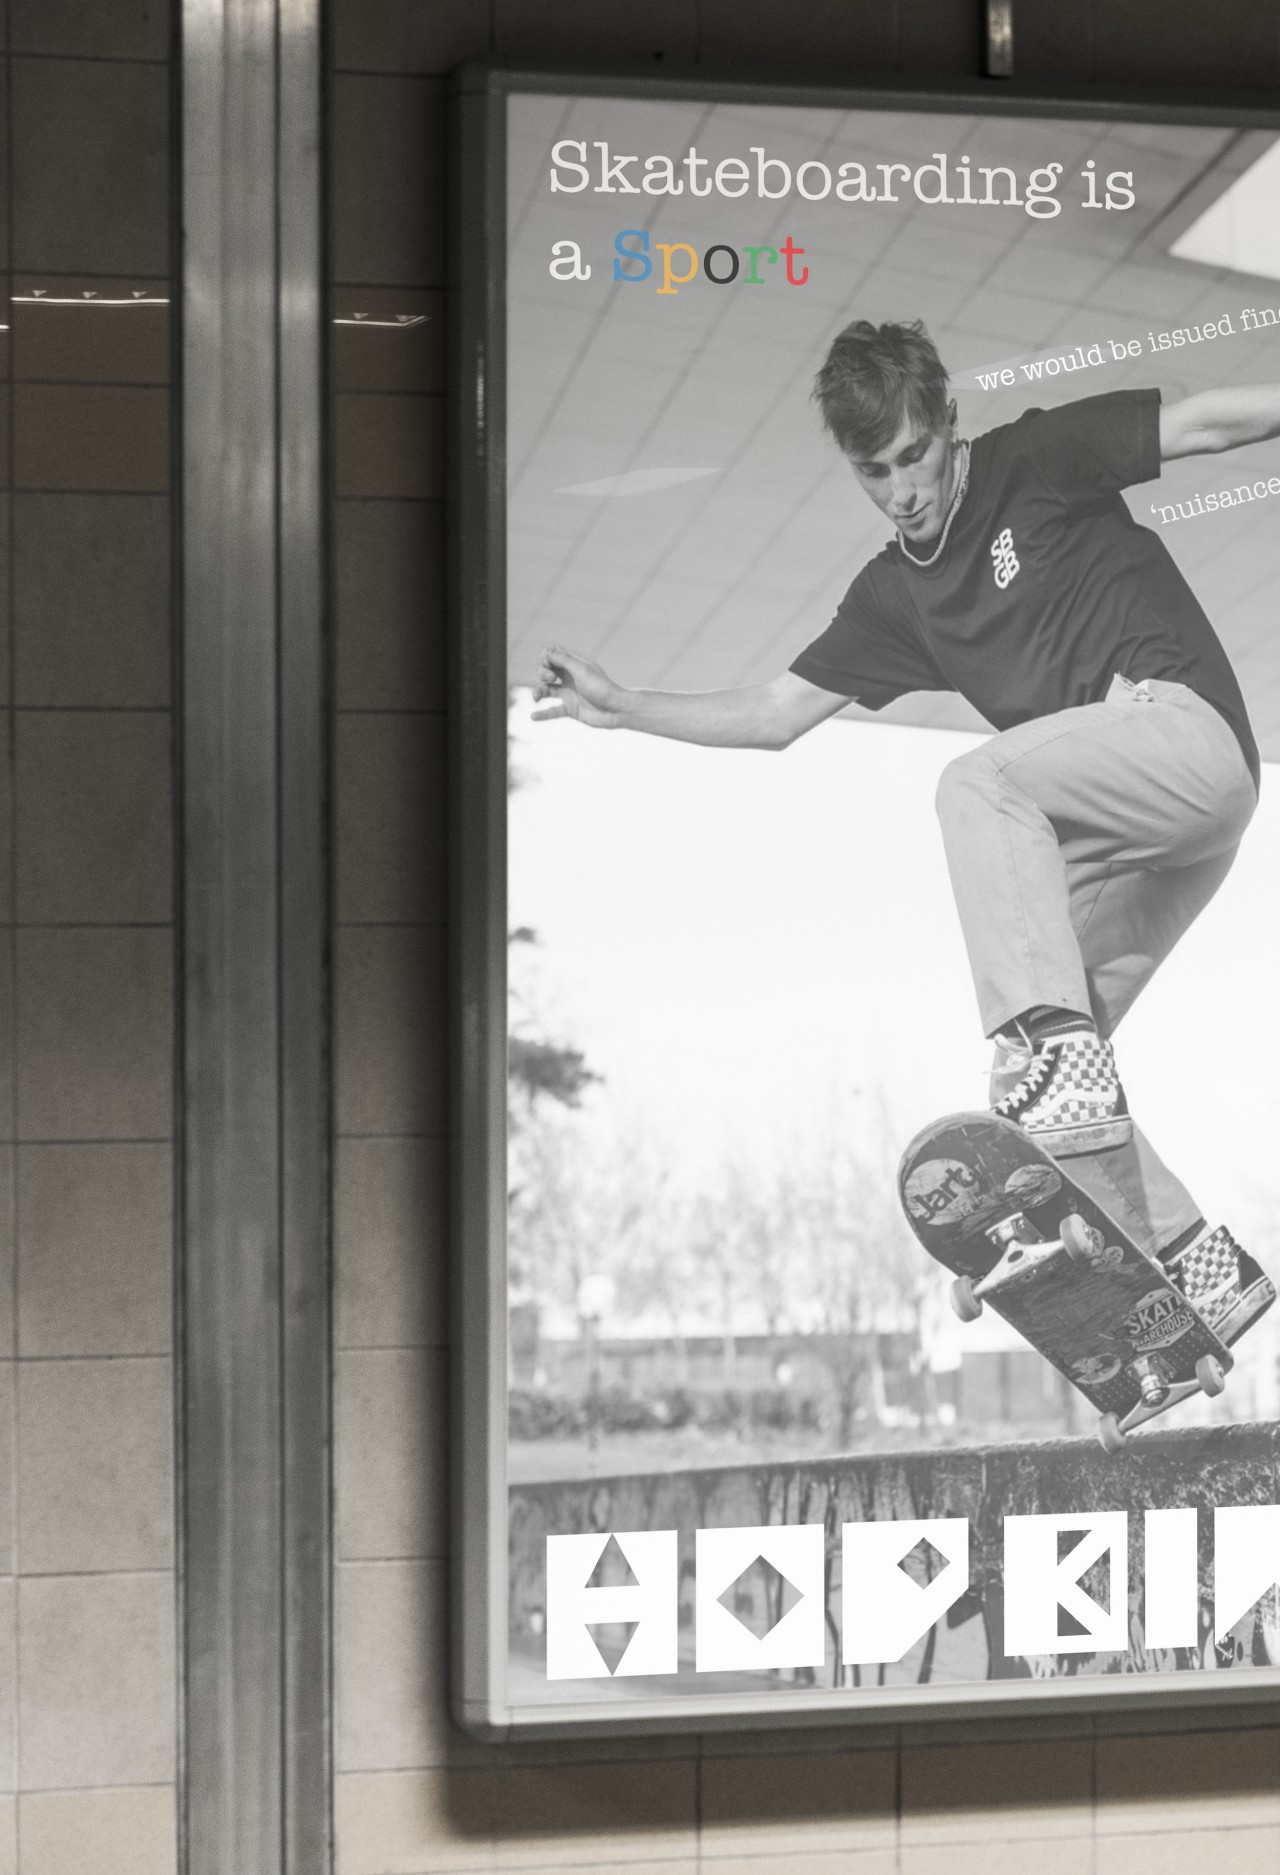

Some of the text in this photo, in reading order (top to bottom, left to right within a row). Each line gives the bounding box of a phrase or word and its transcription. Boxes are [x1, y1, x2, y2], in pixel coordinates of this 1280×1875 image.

[549, 139, 1136, 219] Skateboarding is
[548, 229, 810, 295] a Sport
[974, 368, 1016, 391] we
[1019, 343, 1107, 381] would
[1107, 338, 1143, 361] be
[1147, 314, 1237, 353] issued
